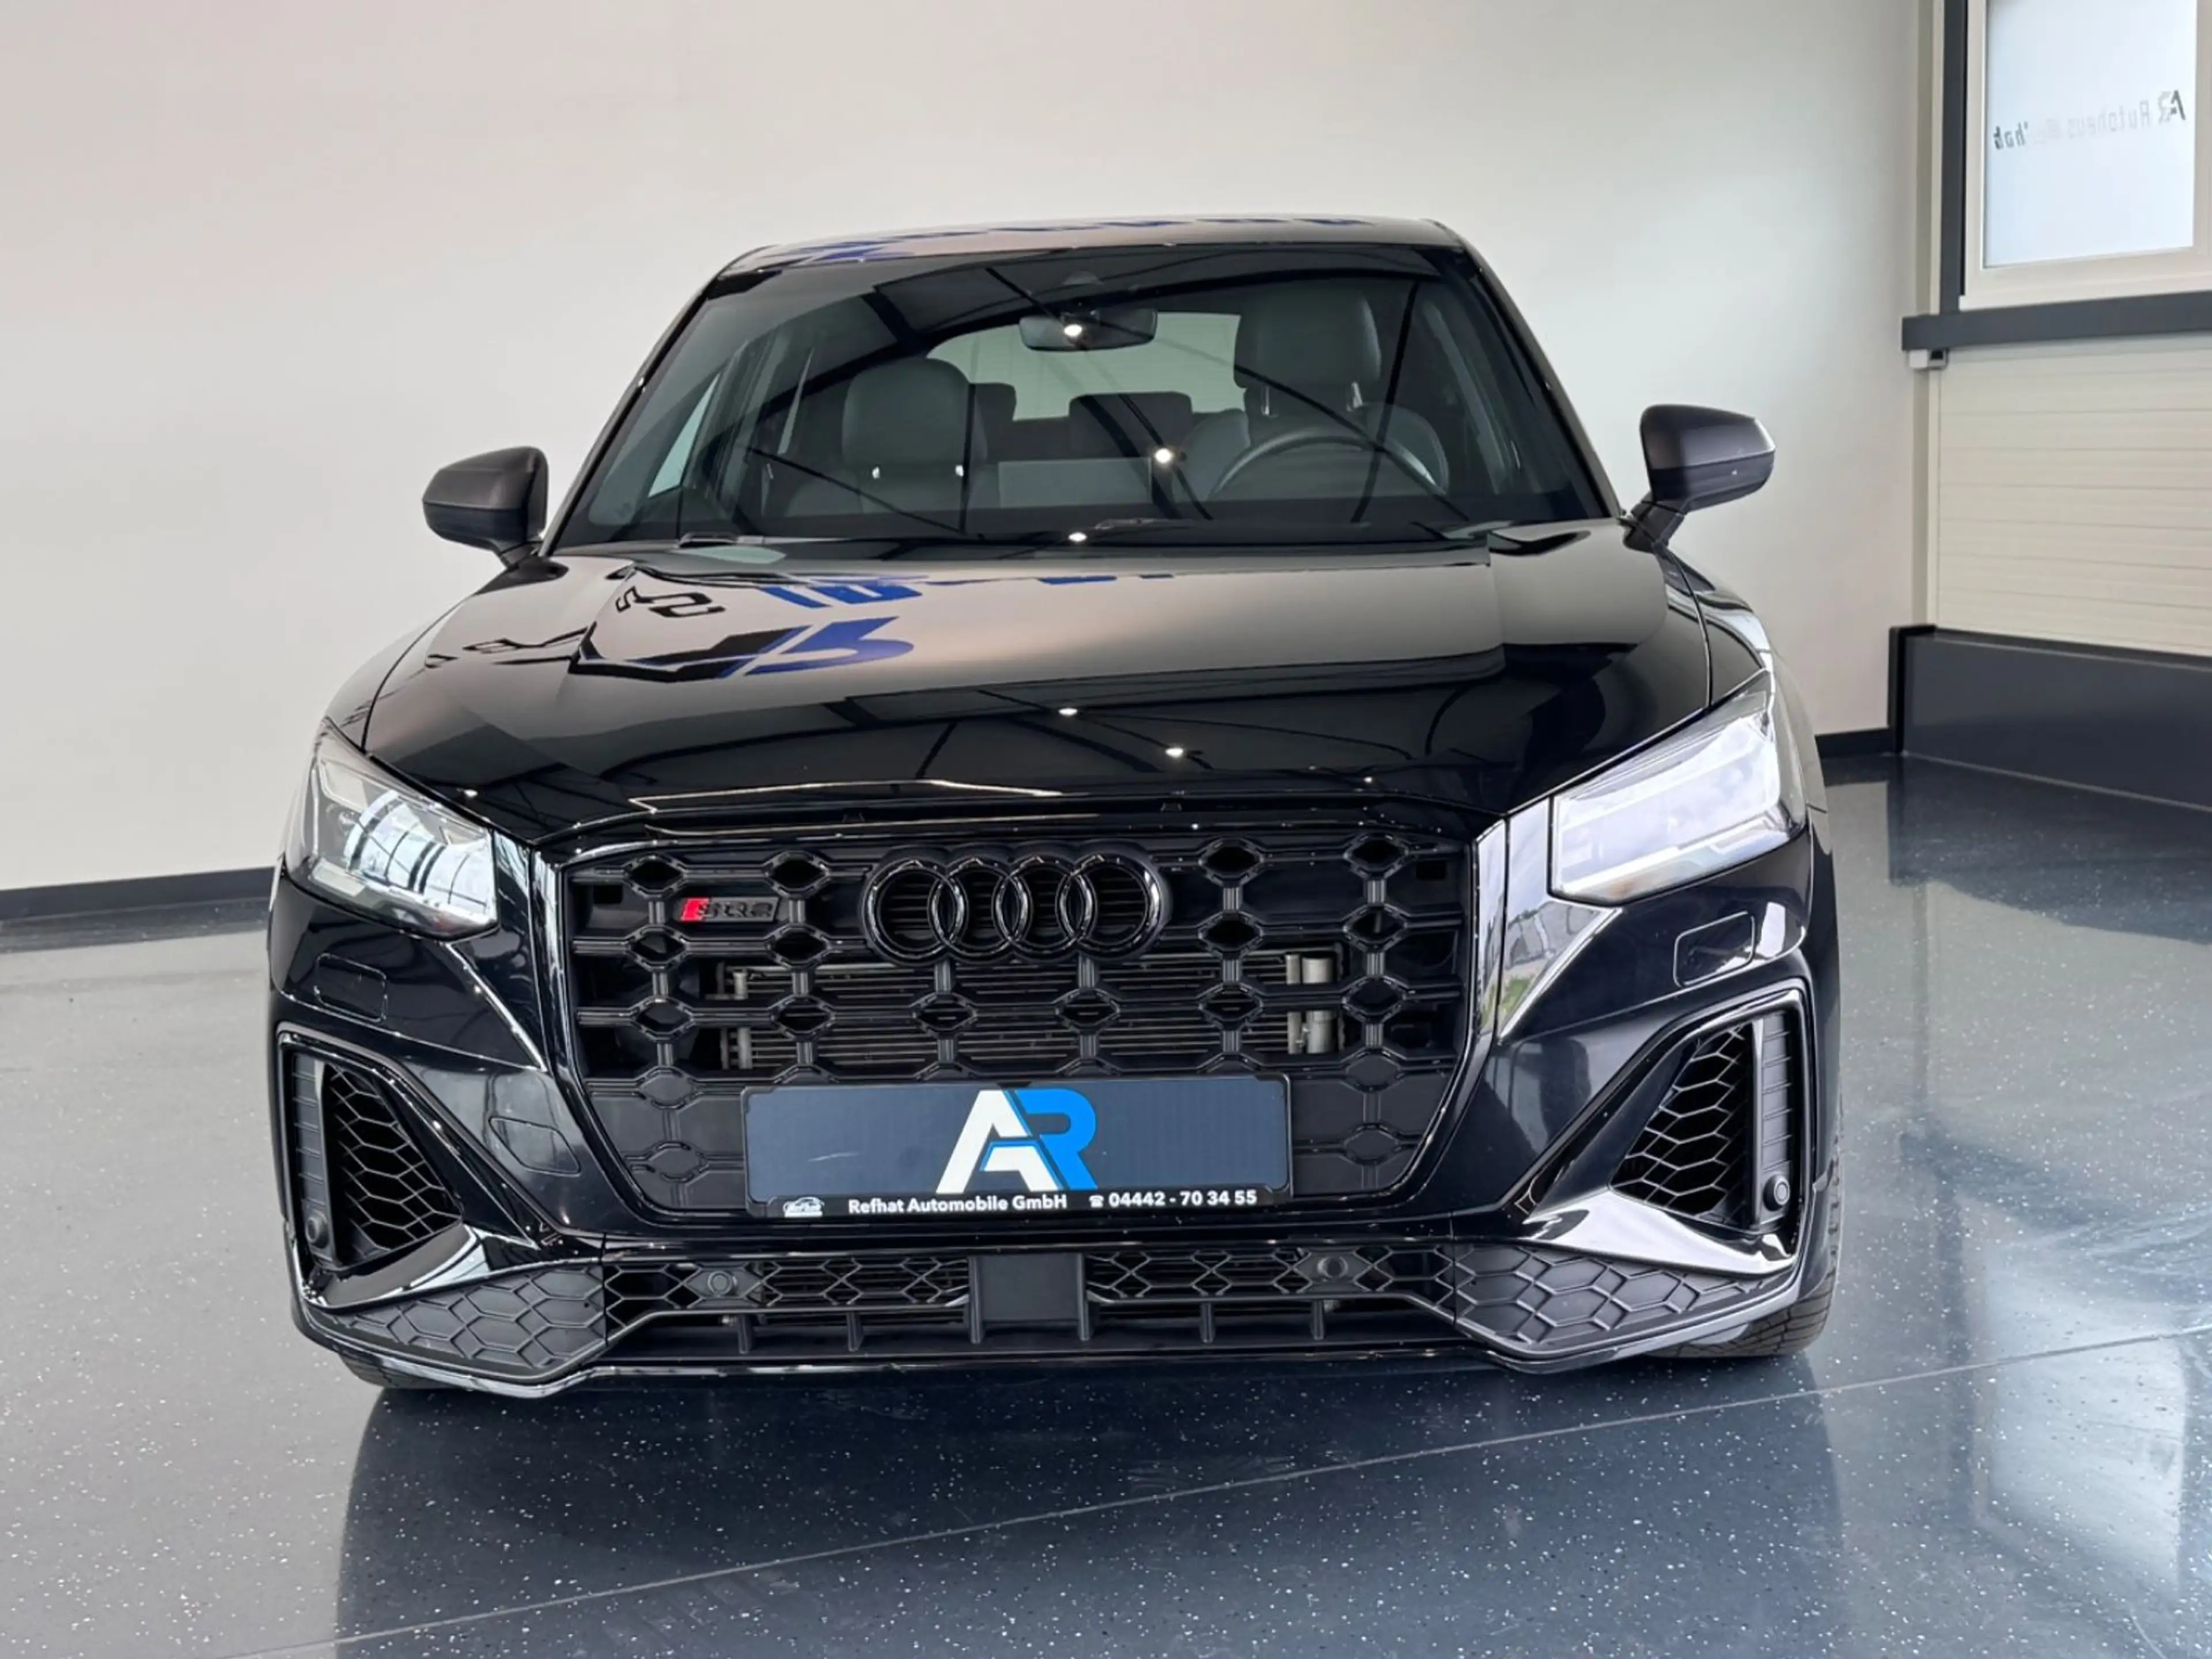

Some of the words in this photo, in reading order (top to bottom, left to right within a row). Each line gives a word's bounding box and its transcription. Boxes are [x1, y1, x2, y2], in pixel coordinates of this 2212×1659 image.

[935, 1088, 1098, 1194] AR
[848, 1198, 905, 1214] Refhat
[906, 1195, 1009, 1213] Automobile
[1012, 1193, 1067, 1211] GmbH
[1108, 1191, 1166, 1208] 04442
[1179, 1190, 1203, 1206] 70
[1207, 1190, 1230, 1206] 34
[1234, 1189, 1257, 1206] 55
